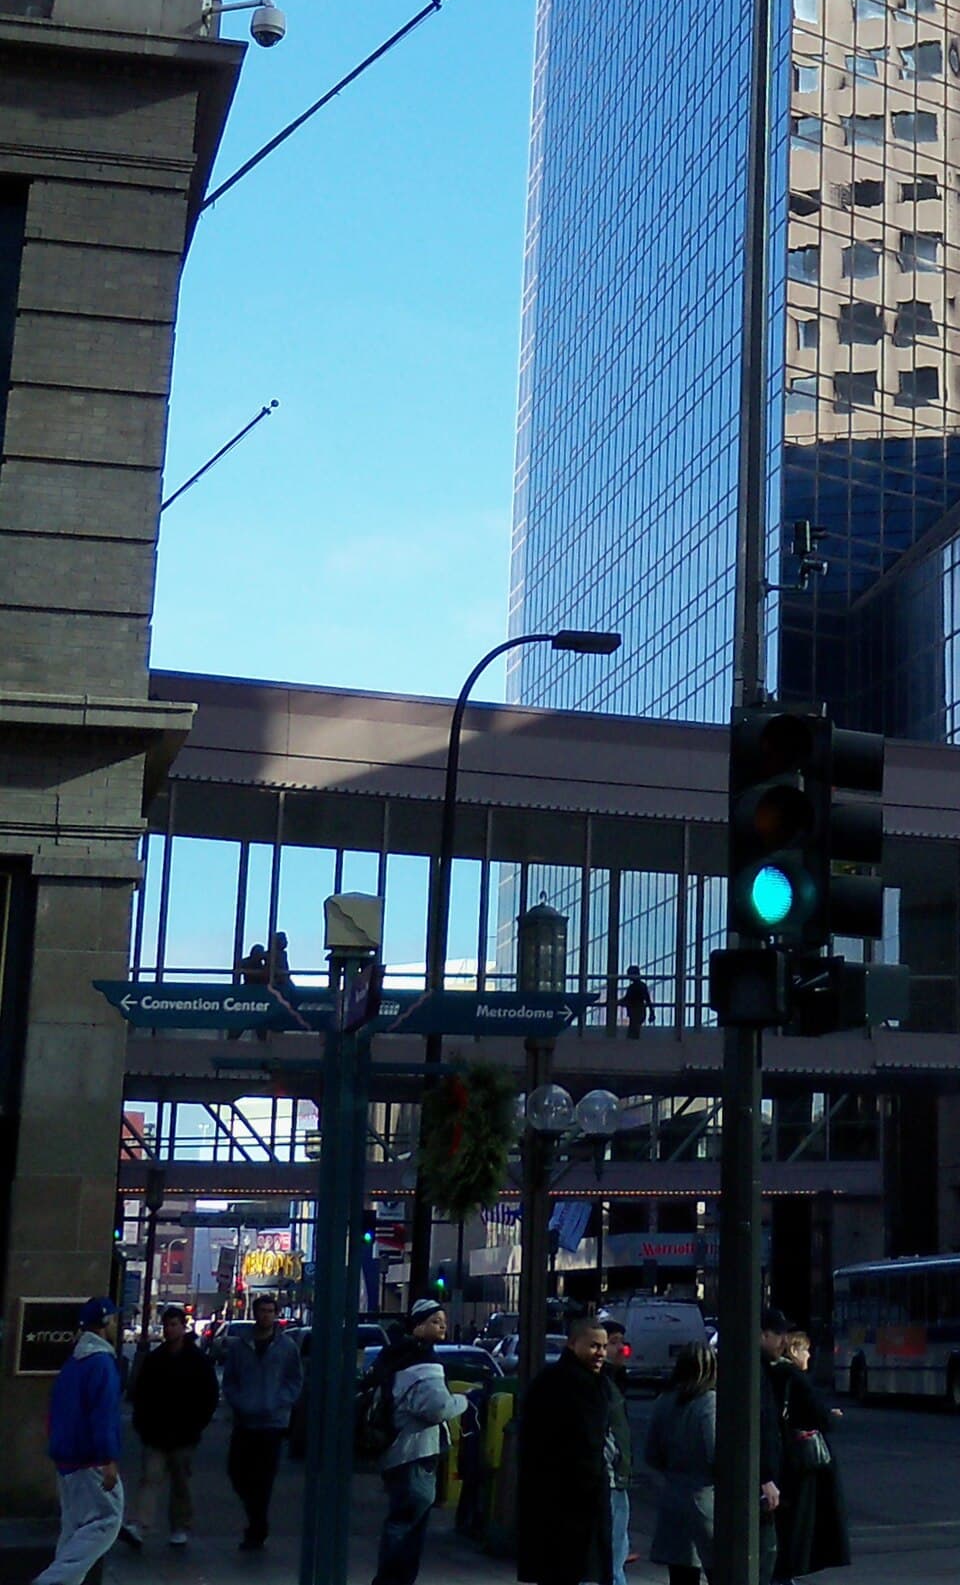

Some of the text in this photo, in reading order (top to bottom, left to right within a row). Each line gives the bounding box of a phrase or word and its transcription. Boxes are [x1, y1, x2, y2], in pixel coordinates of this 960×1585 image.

[141, 995, 270, 1012] Convention Center
[476, 1004, 554, 1018] Metrodome
[639, 1242, 696, 1257] Marriott
